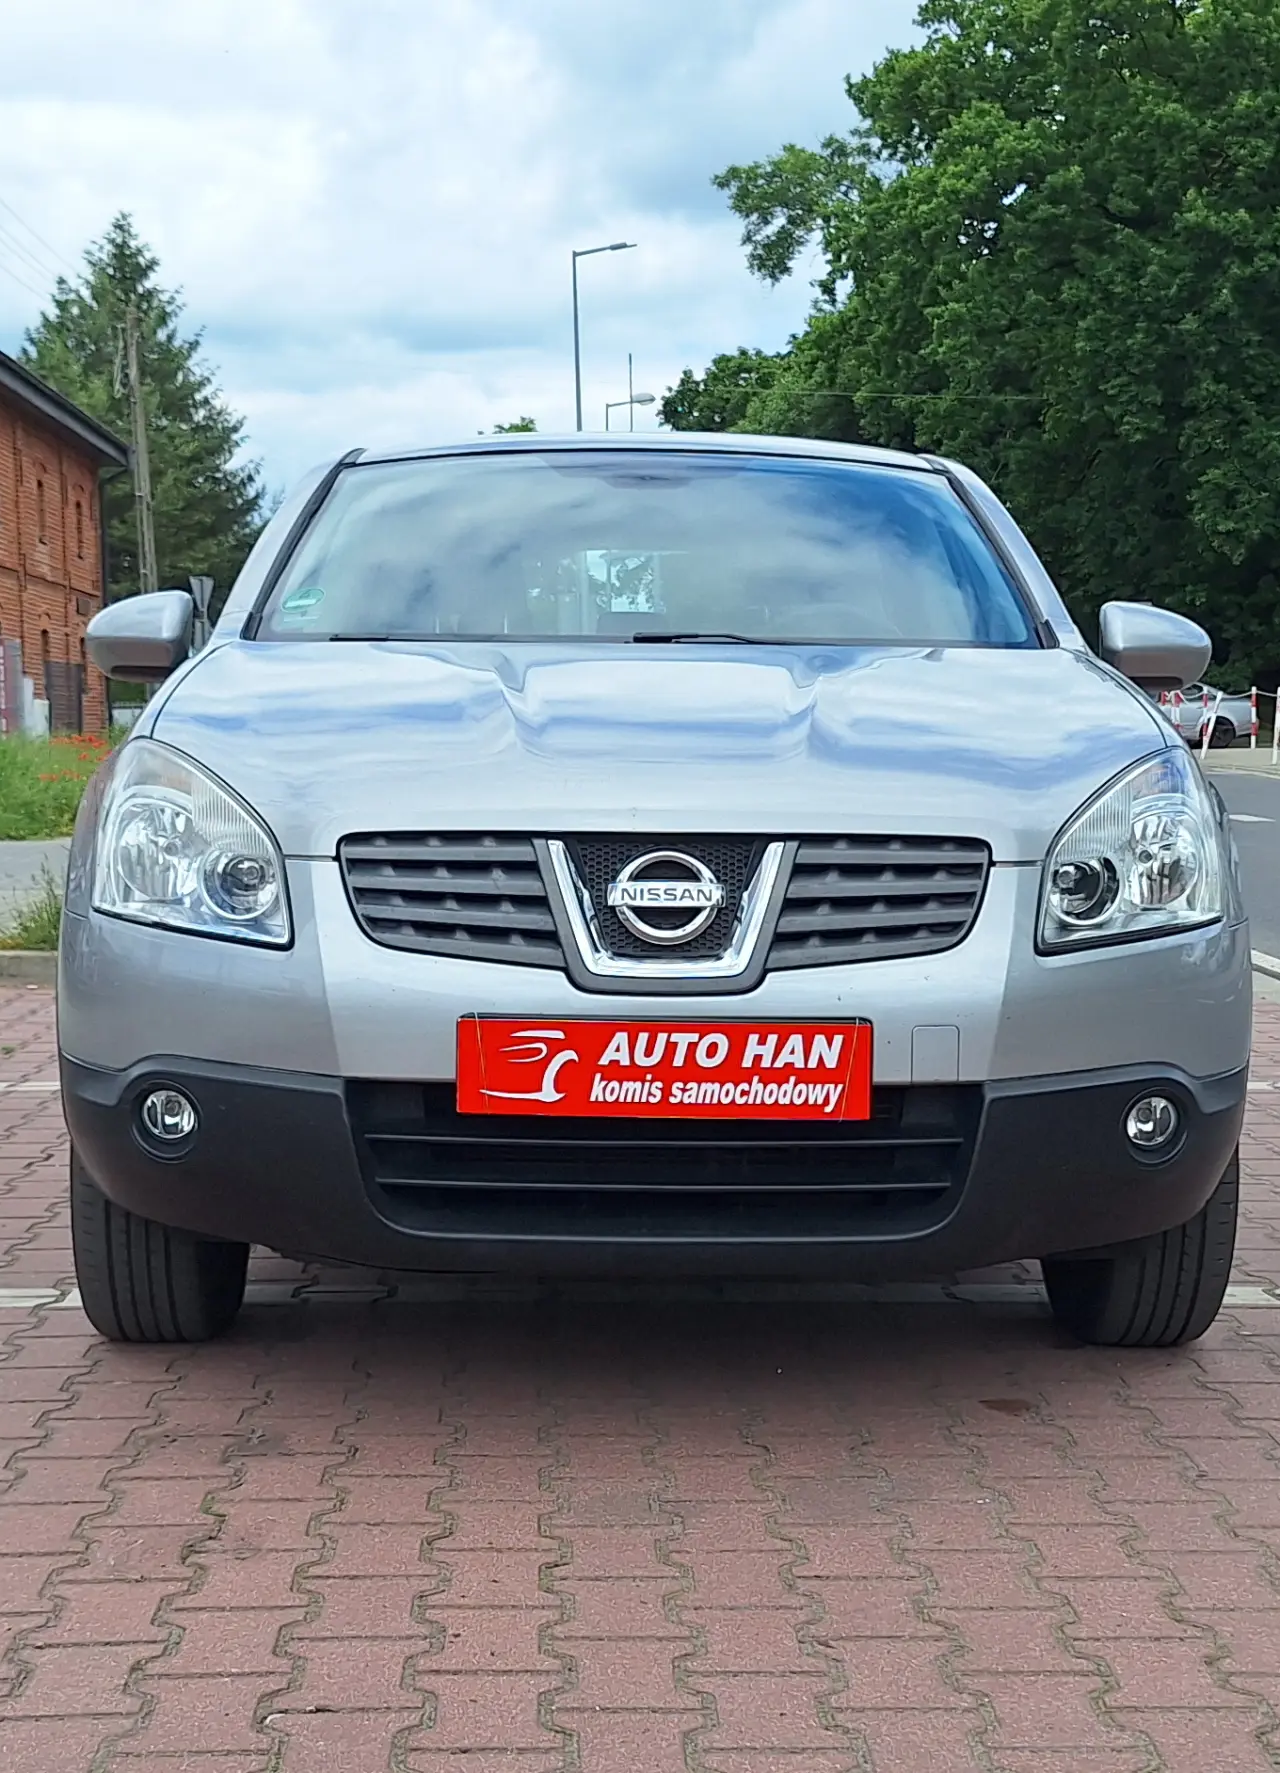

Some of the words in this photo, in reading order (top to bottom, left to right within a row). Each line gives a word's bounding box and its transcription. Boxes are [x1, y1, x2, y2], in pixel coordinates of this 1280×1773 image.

[621, 888, 713, 902] NISSAN
[598, 1031, 730, 1068] AUTO
[741, 1034, 845, 1069] HAN
[589, 1073, 663, 1104] komis
[668, 1075, 843, 1113] samochodowy
